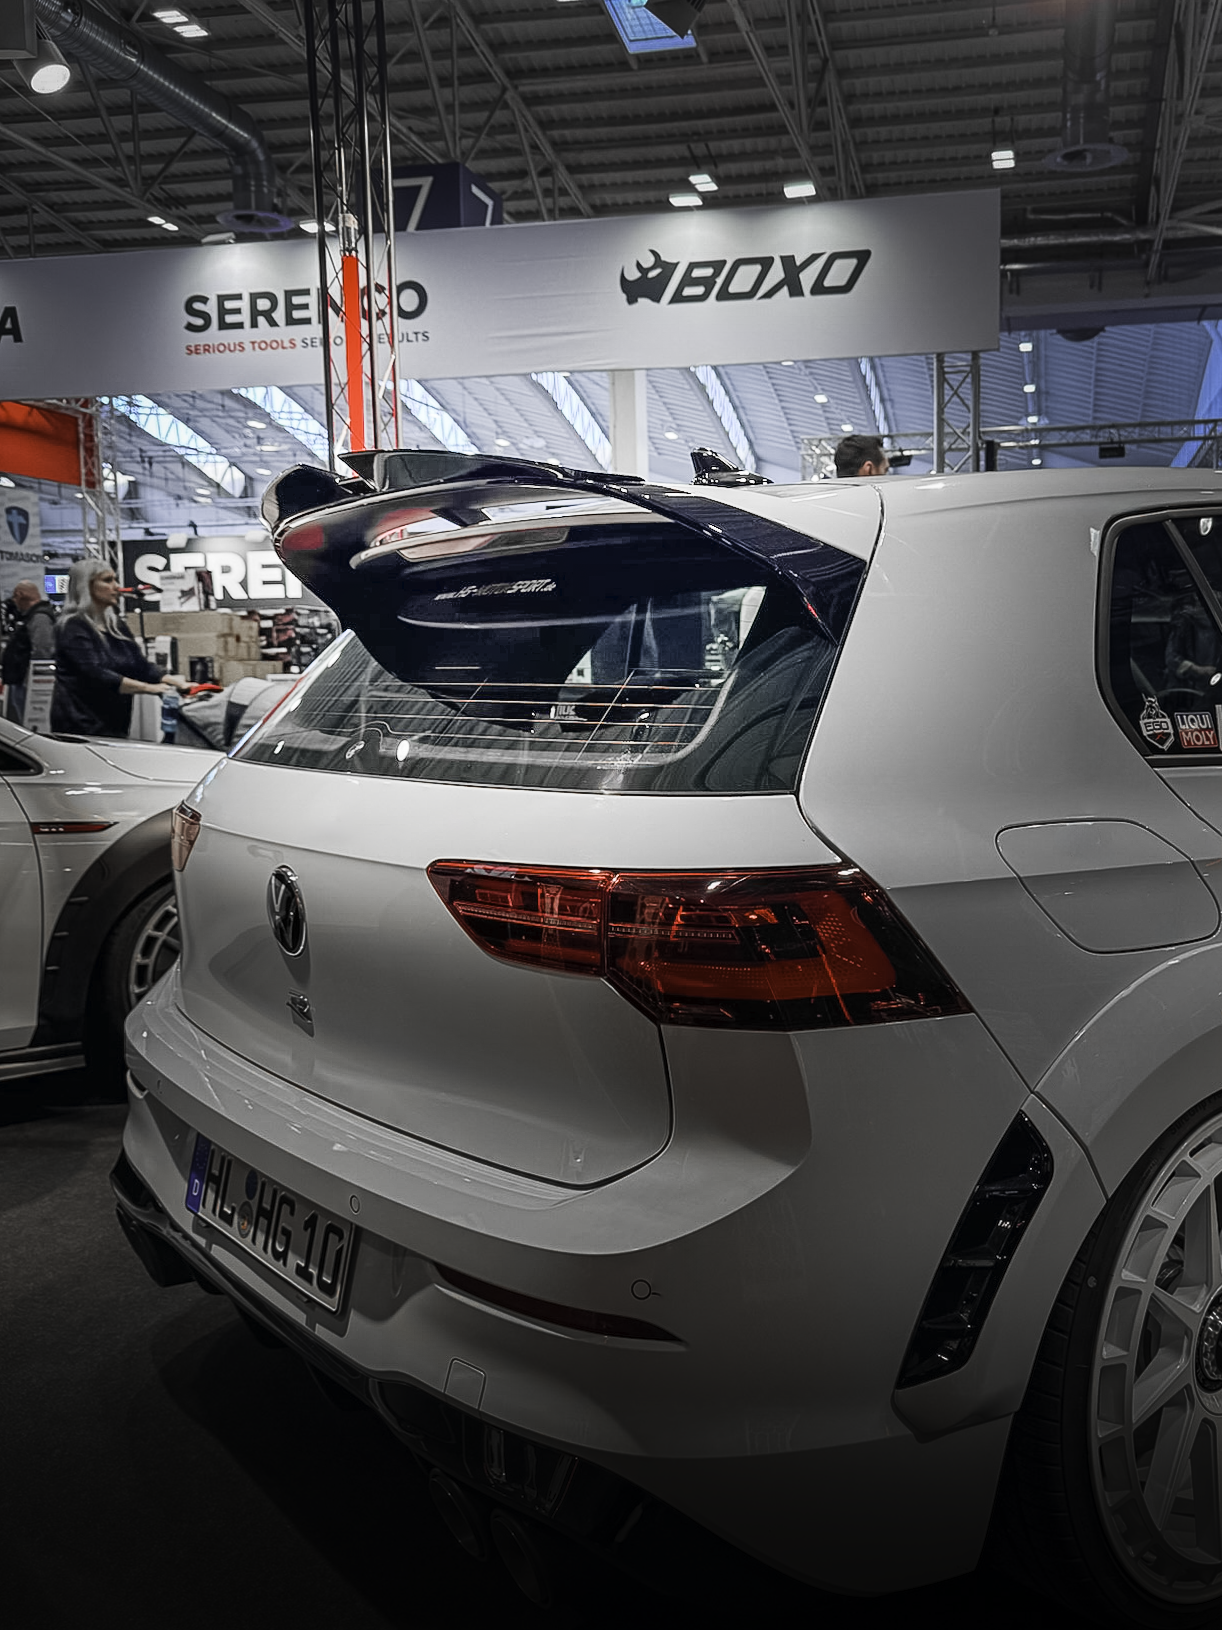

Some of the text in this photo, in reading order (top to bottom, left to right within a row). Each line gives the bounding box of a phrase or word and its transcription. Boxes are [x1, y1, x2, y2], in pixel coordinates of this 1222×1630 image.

[667, 249, 872, 305] BOXO
[185, 341, 245, 356] SERIOUS
[249, 338, 297, 351] TOOLS
[1144, 722, 1169, 733] EGO
[1176, 714, 1212, 729] LIQUI
[1181, 731, 1214, 746] MOLY
[192, 1148, 345, 1299] D HL HG 10
